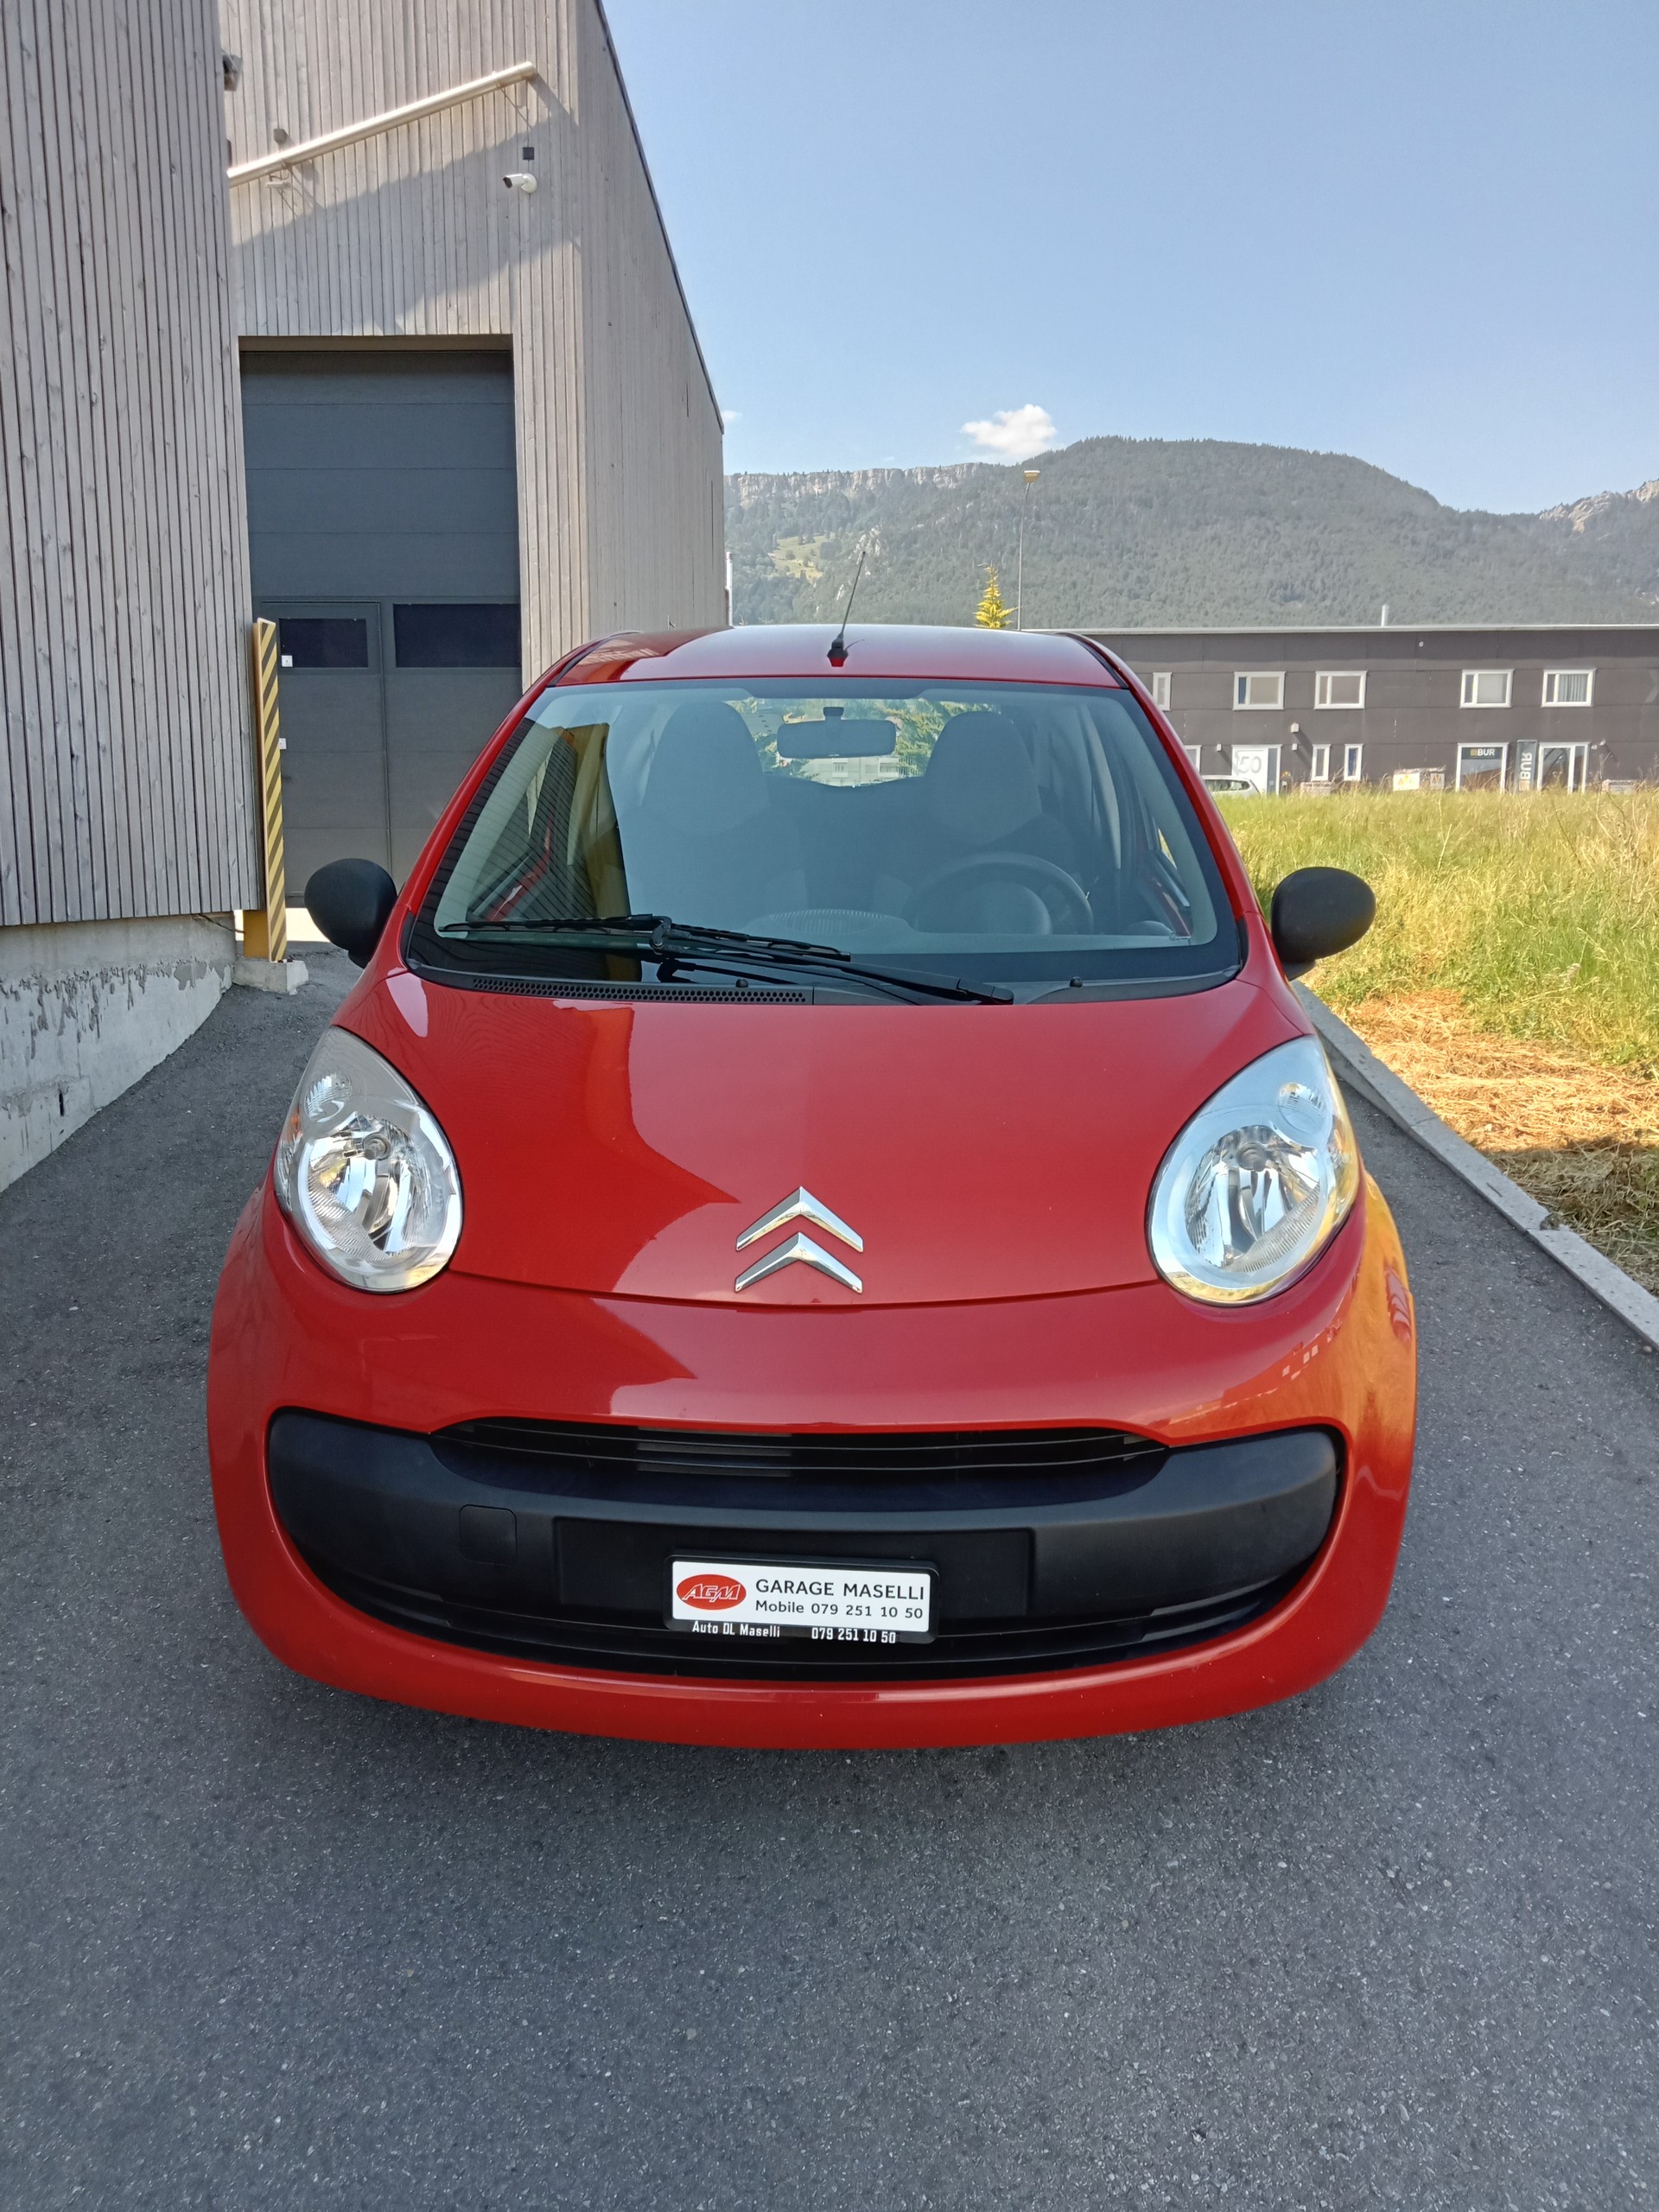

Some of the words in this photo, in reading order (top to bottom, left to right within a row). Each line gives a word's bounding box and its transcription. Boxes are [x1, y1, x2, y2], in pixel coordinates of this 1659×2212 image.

[1237, 755, 1262, 774] 50
[1520, 752, 1532, 780] BUR
[682, 1583, 741, 1603] AGM
[755, 1579, 834, 1596] GARAGE
[842, 1583, 925, 1600] MASELLI
[755, 1599, 804, 1613] Mobile
[810, 1603, 838, 1615] 079
[845, 1605, 872, 1617] 251
[880, 1606, 898, 1618] 10
[905, 1607, 924, 1619] 50
[692, 1620, 719, 1634] Auto
[722, 1622, 735, 1636] DL
[740, 1624, 780, 1637] Maselli
[811, 1627, 834, 1640] 079
[837, 1628, 859, 1641] 251
[862, 1630, 877, 1643] 10
[880, 1631, 896, 1644] 50
